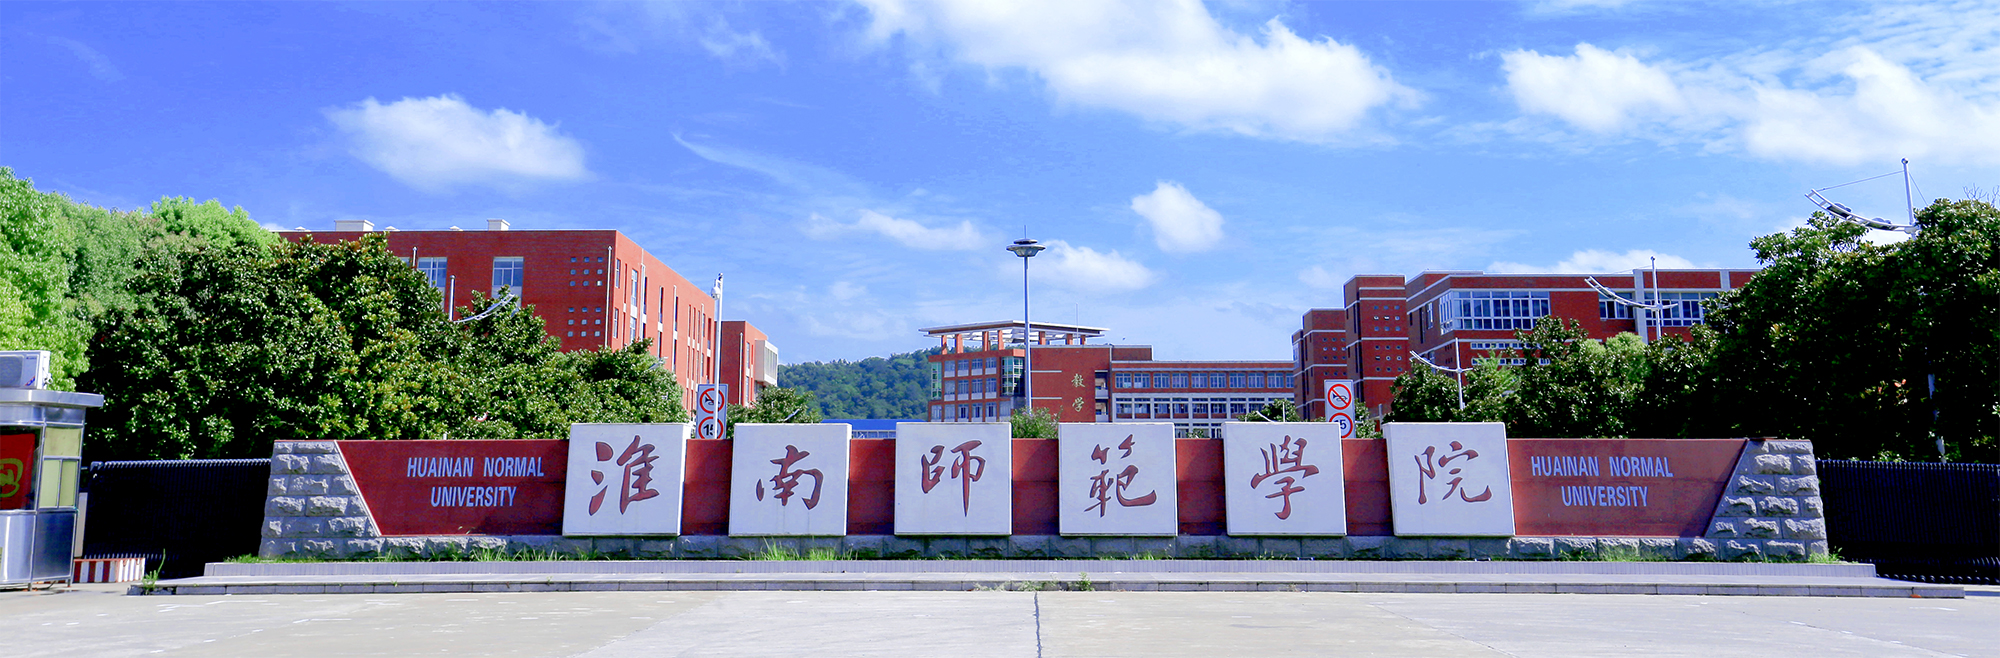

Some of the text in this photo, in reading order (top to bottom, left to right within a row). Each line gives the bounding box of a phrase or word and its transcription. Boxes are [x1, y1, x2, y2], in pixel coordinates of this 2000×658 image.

[407, 456, 545, 478] HUAINAN NORMAL
[1531, 456, 1674, 478] HUAINAN NORMAL
[431, 486, 517, 507] UNIVERSITY
[1561, 485, 1649, 507] UNIVERSITY
